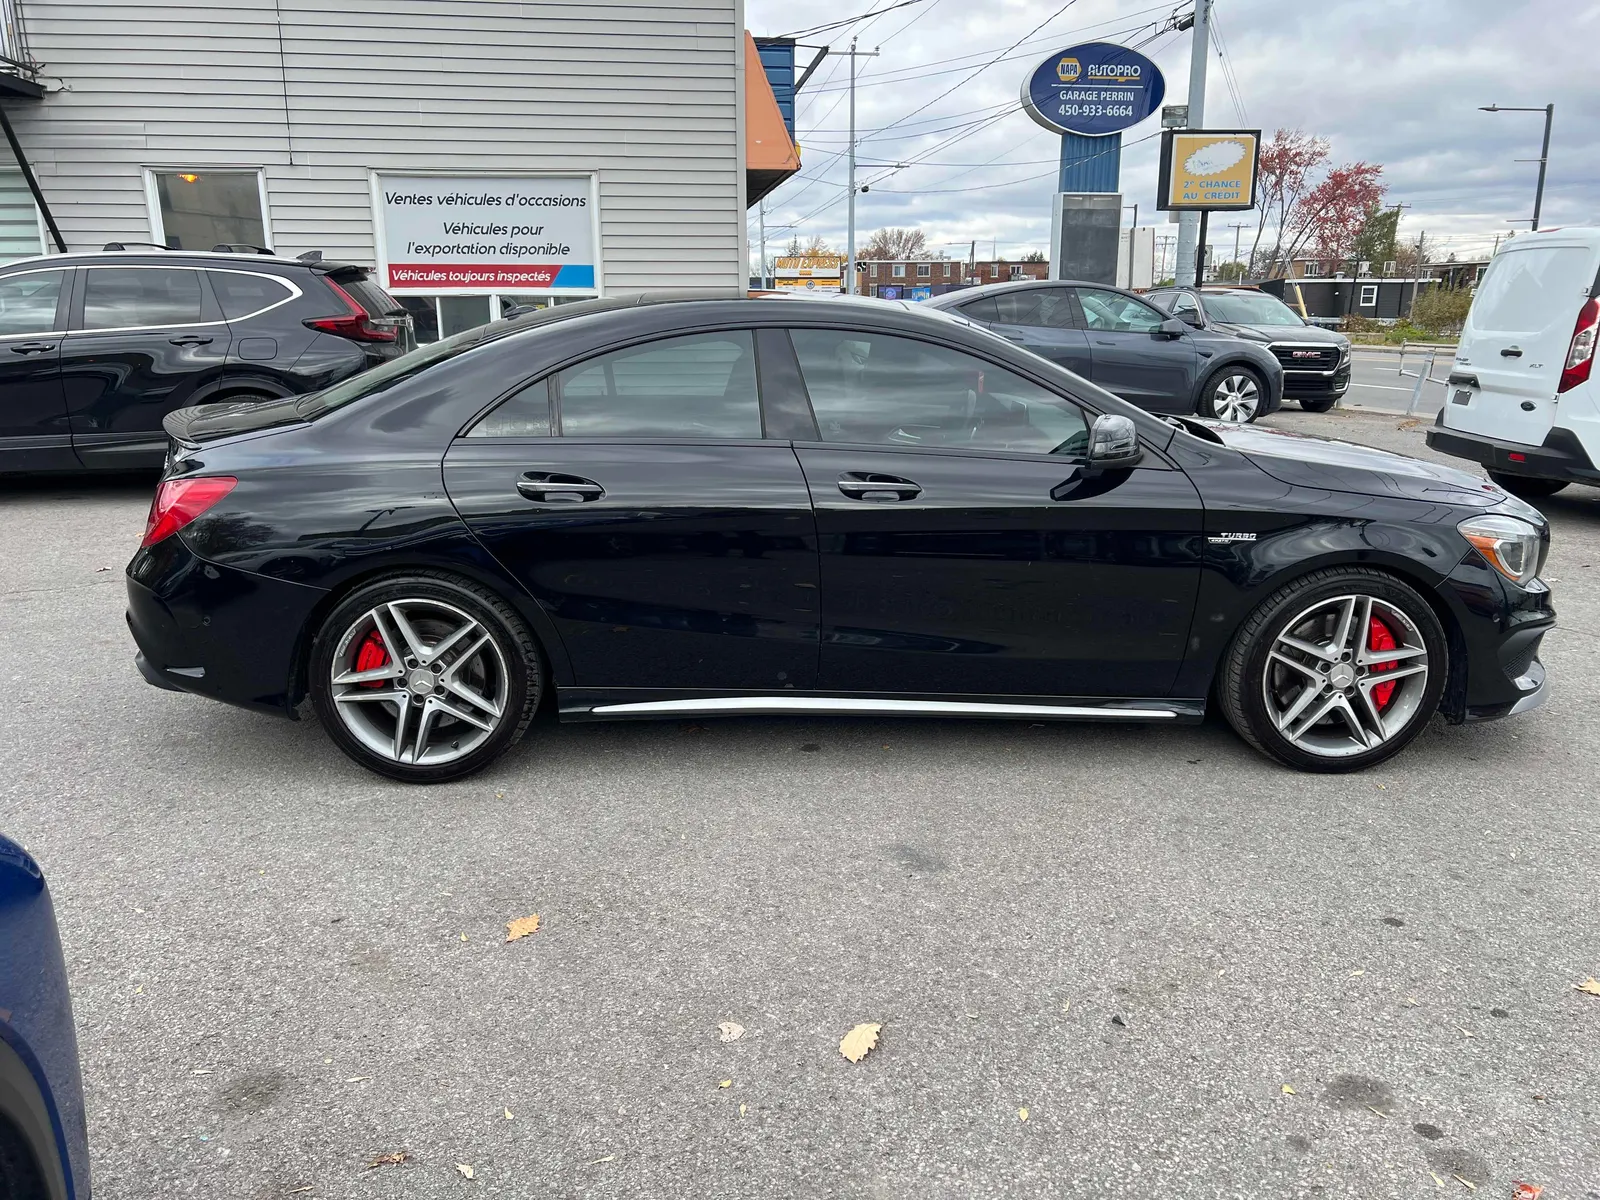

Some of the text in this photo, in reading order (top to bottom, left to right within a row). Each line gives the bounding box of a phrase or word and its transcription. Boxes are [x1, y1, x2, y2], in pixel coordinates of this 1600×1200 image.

[1061, 64, 1141, 76] NAPA AUTOPRO
[1060, 91, 1134, 101] GARAGE PERRIN
[1058, 104, 1133, 116] 450-933-6664
[385, 192, 586, 207] Ventes véhicules d'occasions
[1204, 190, 1240, 199] CRÉDIT
[443, 222, 544, 238] Véhicules pour
[407, 242, 570, 257] l'exportation disponible
[800, 257, 839, 269] EXPRESS
[392, 269, 551, 283] Véhicules toujours inspectés
